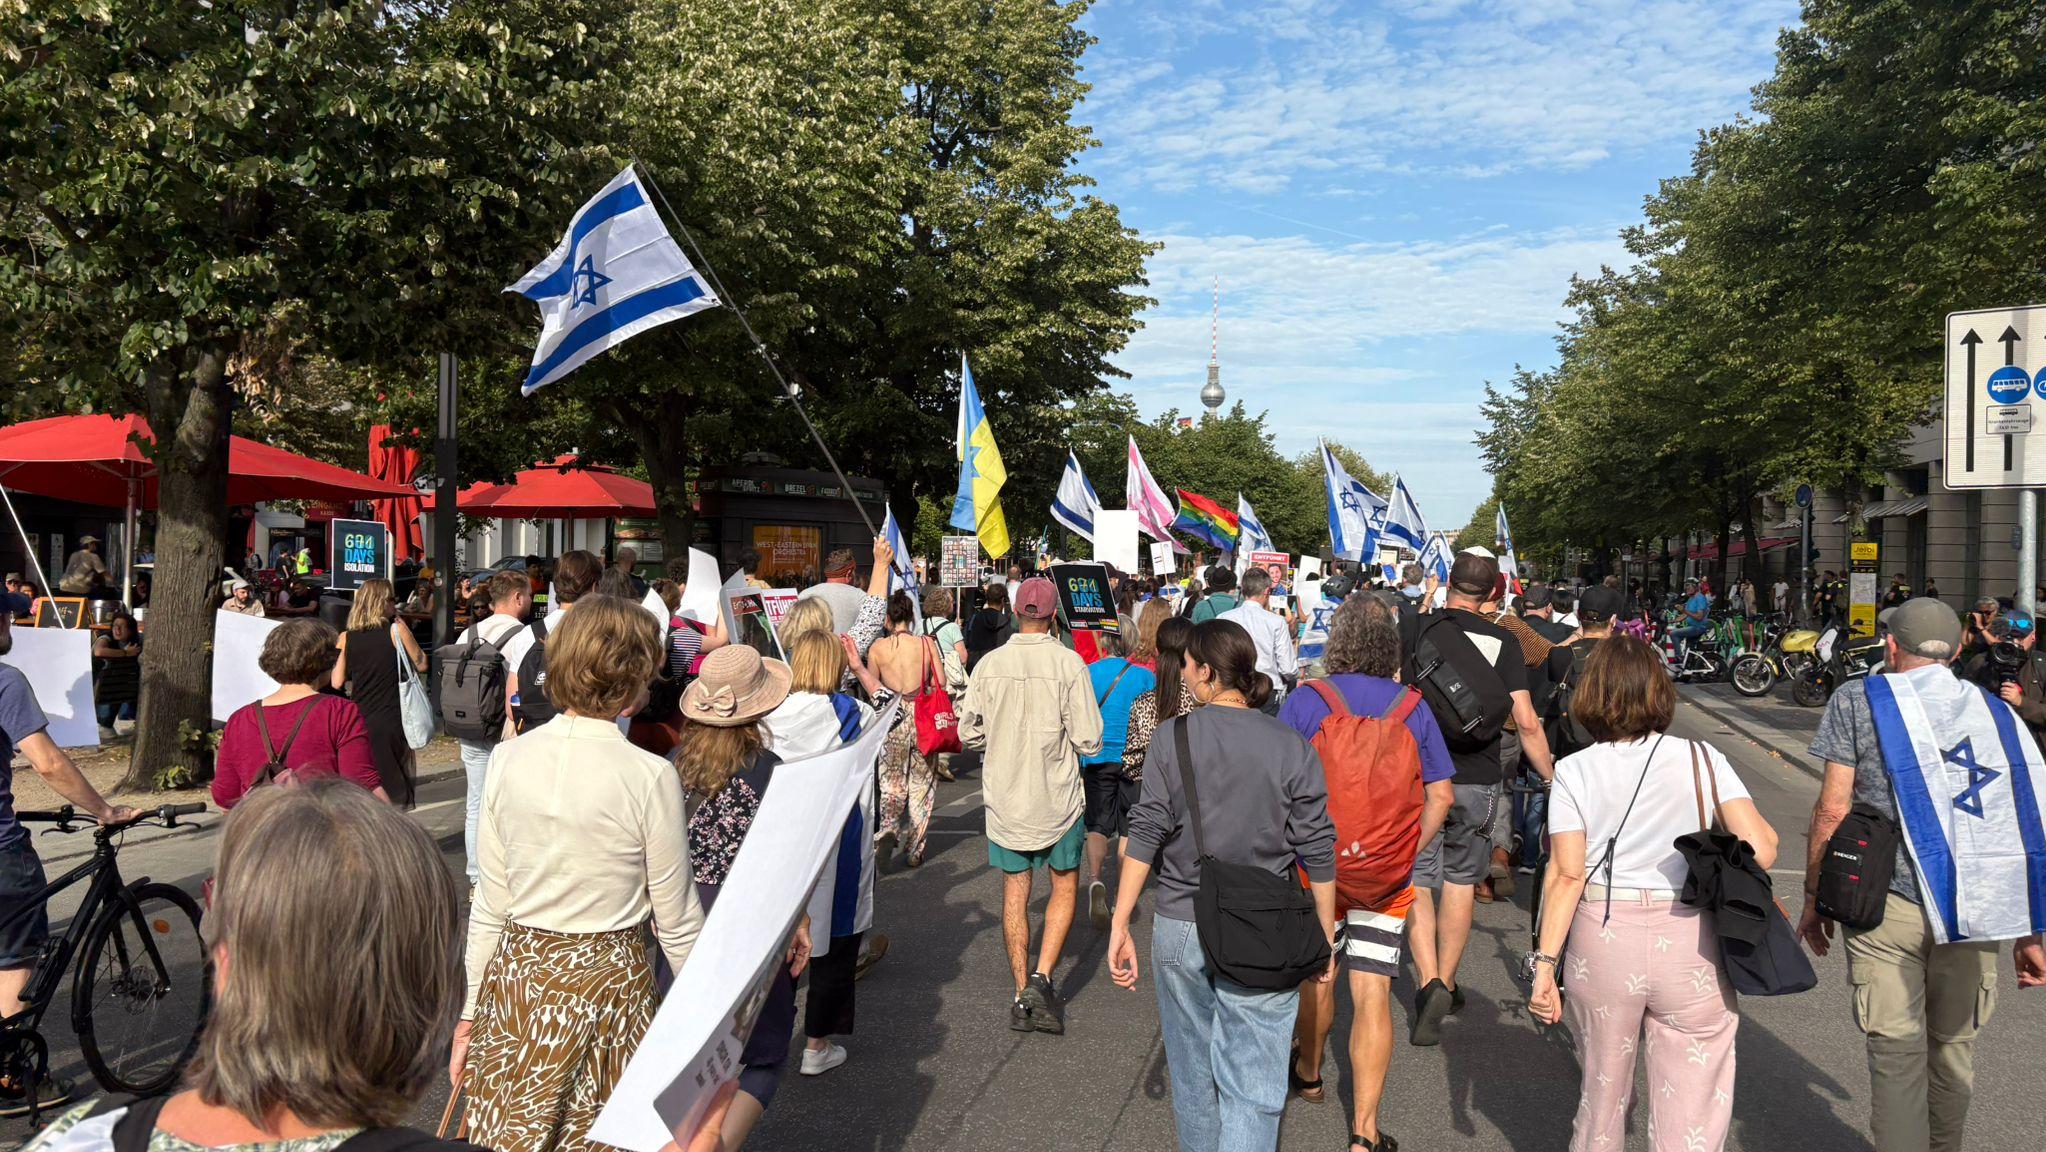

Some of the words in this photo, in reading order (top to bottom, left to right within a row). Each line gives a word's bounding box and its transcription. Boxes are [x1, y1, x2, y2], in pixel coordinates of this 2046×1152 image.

[344, 548, 375, 564] DAYS
[344, 562, 375, 573] ISOLATION
[1071, 592, 1103, 607] DAYS
